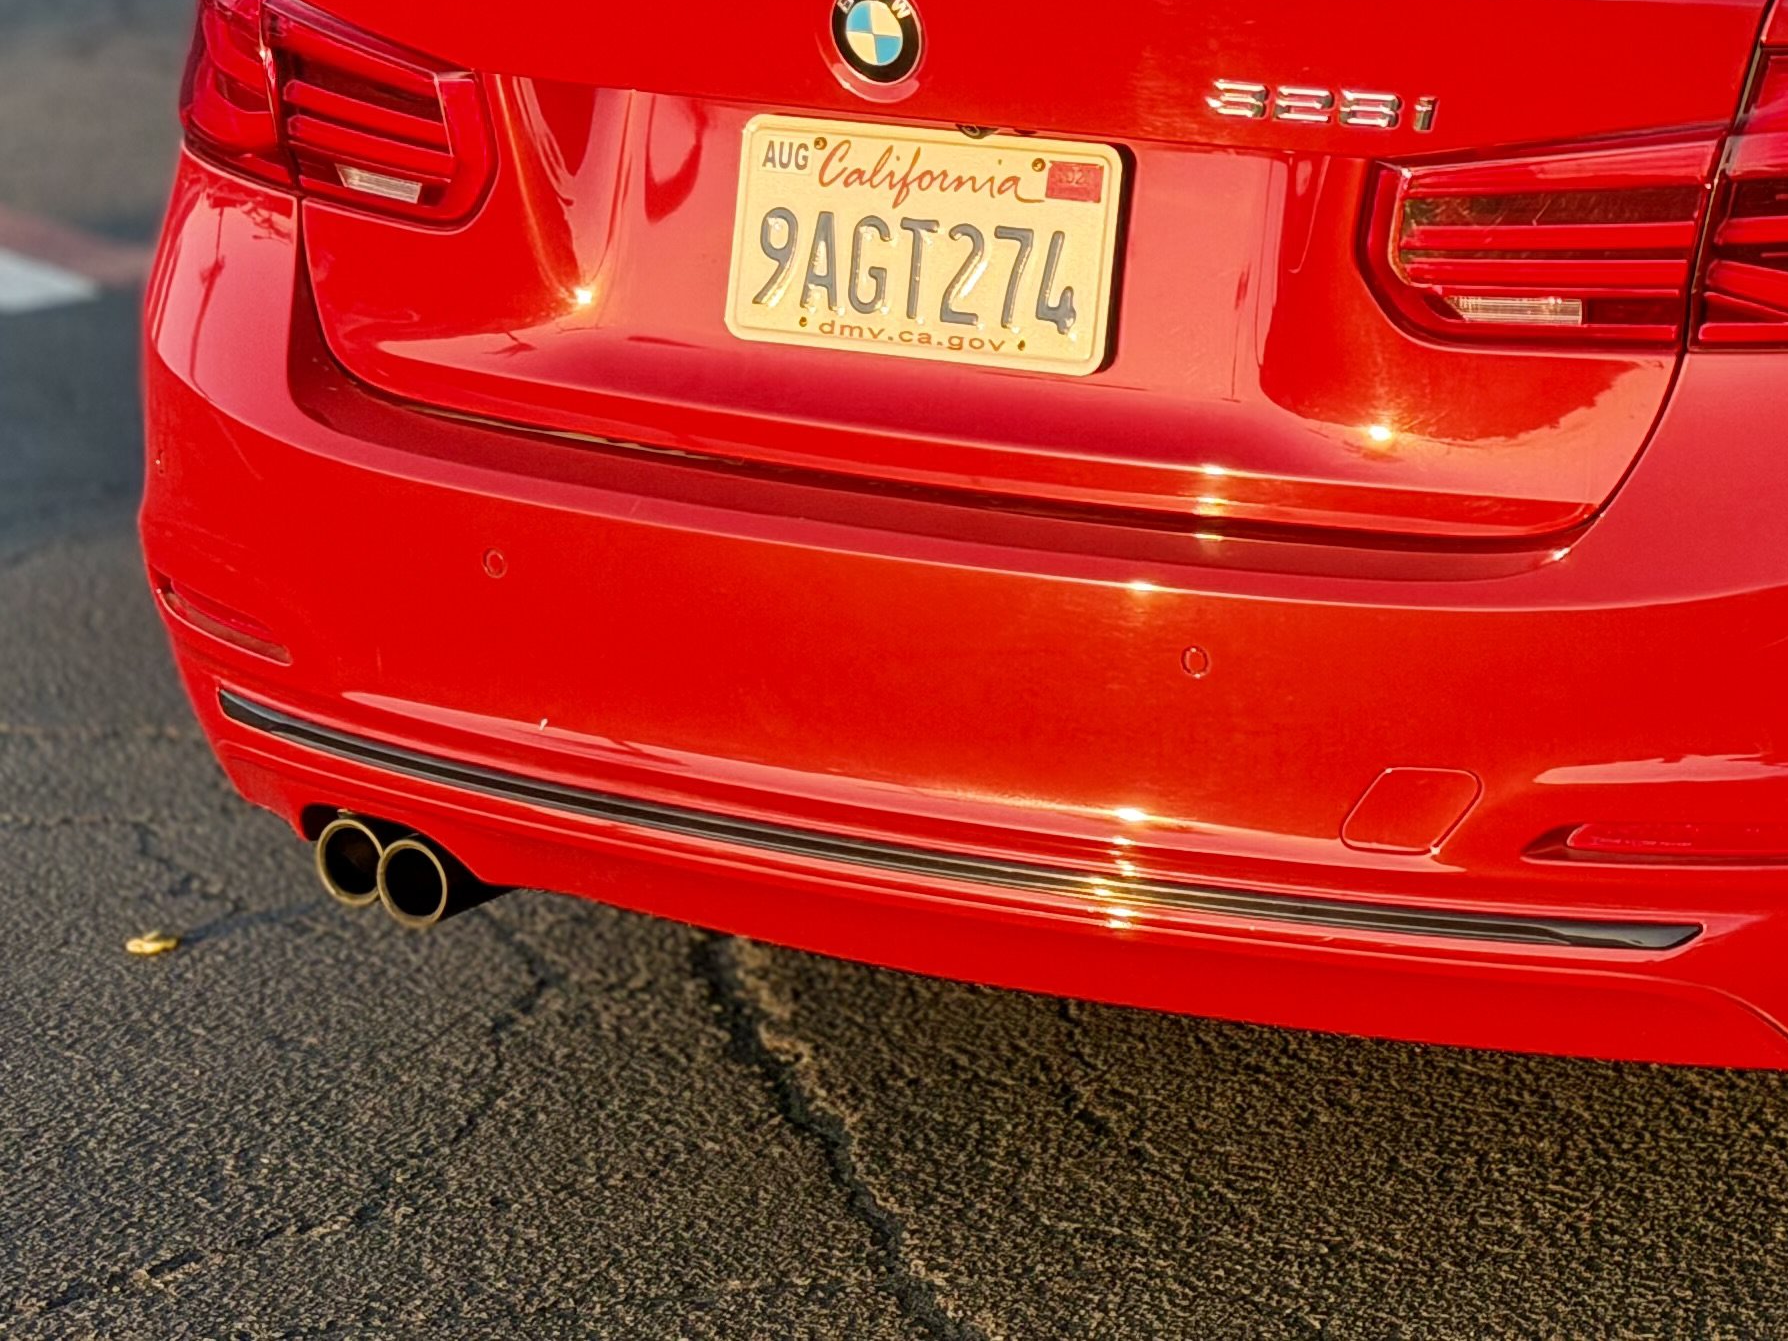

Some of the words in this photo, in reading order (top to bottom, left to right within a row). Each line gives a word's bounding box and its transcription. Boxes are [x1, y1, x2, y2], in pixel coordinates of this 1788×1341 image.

[1204, 78, 1440, 133] 328i
[761, 140, 810, 171] AUG
[818, 139, 1045, 209] California
[752, 206, 1078, 336] 9AGT274
[818, 319, 1006, 352] dmv.ca.gov
